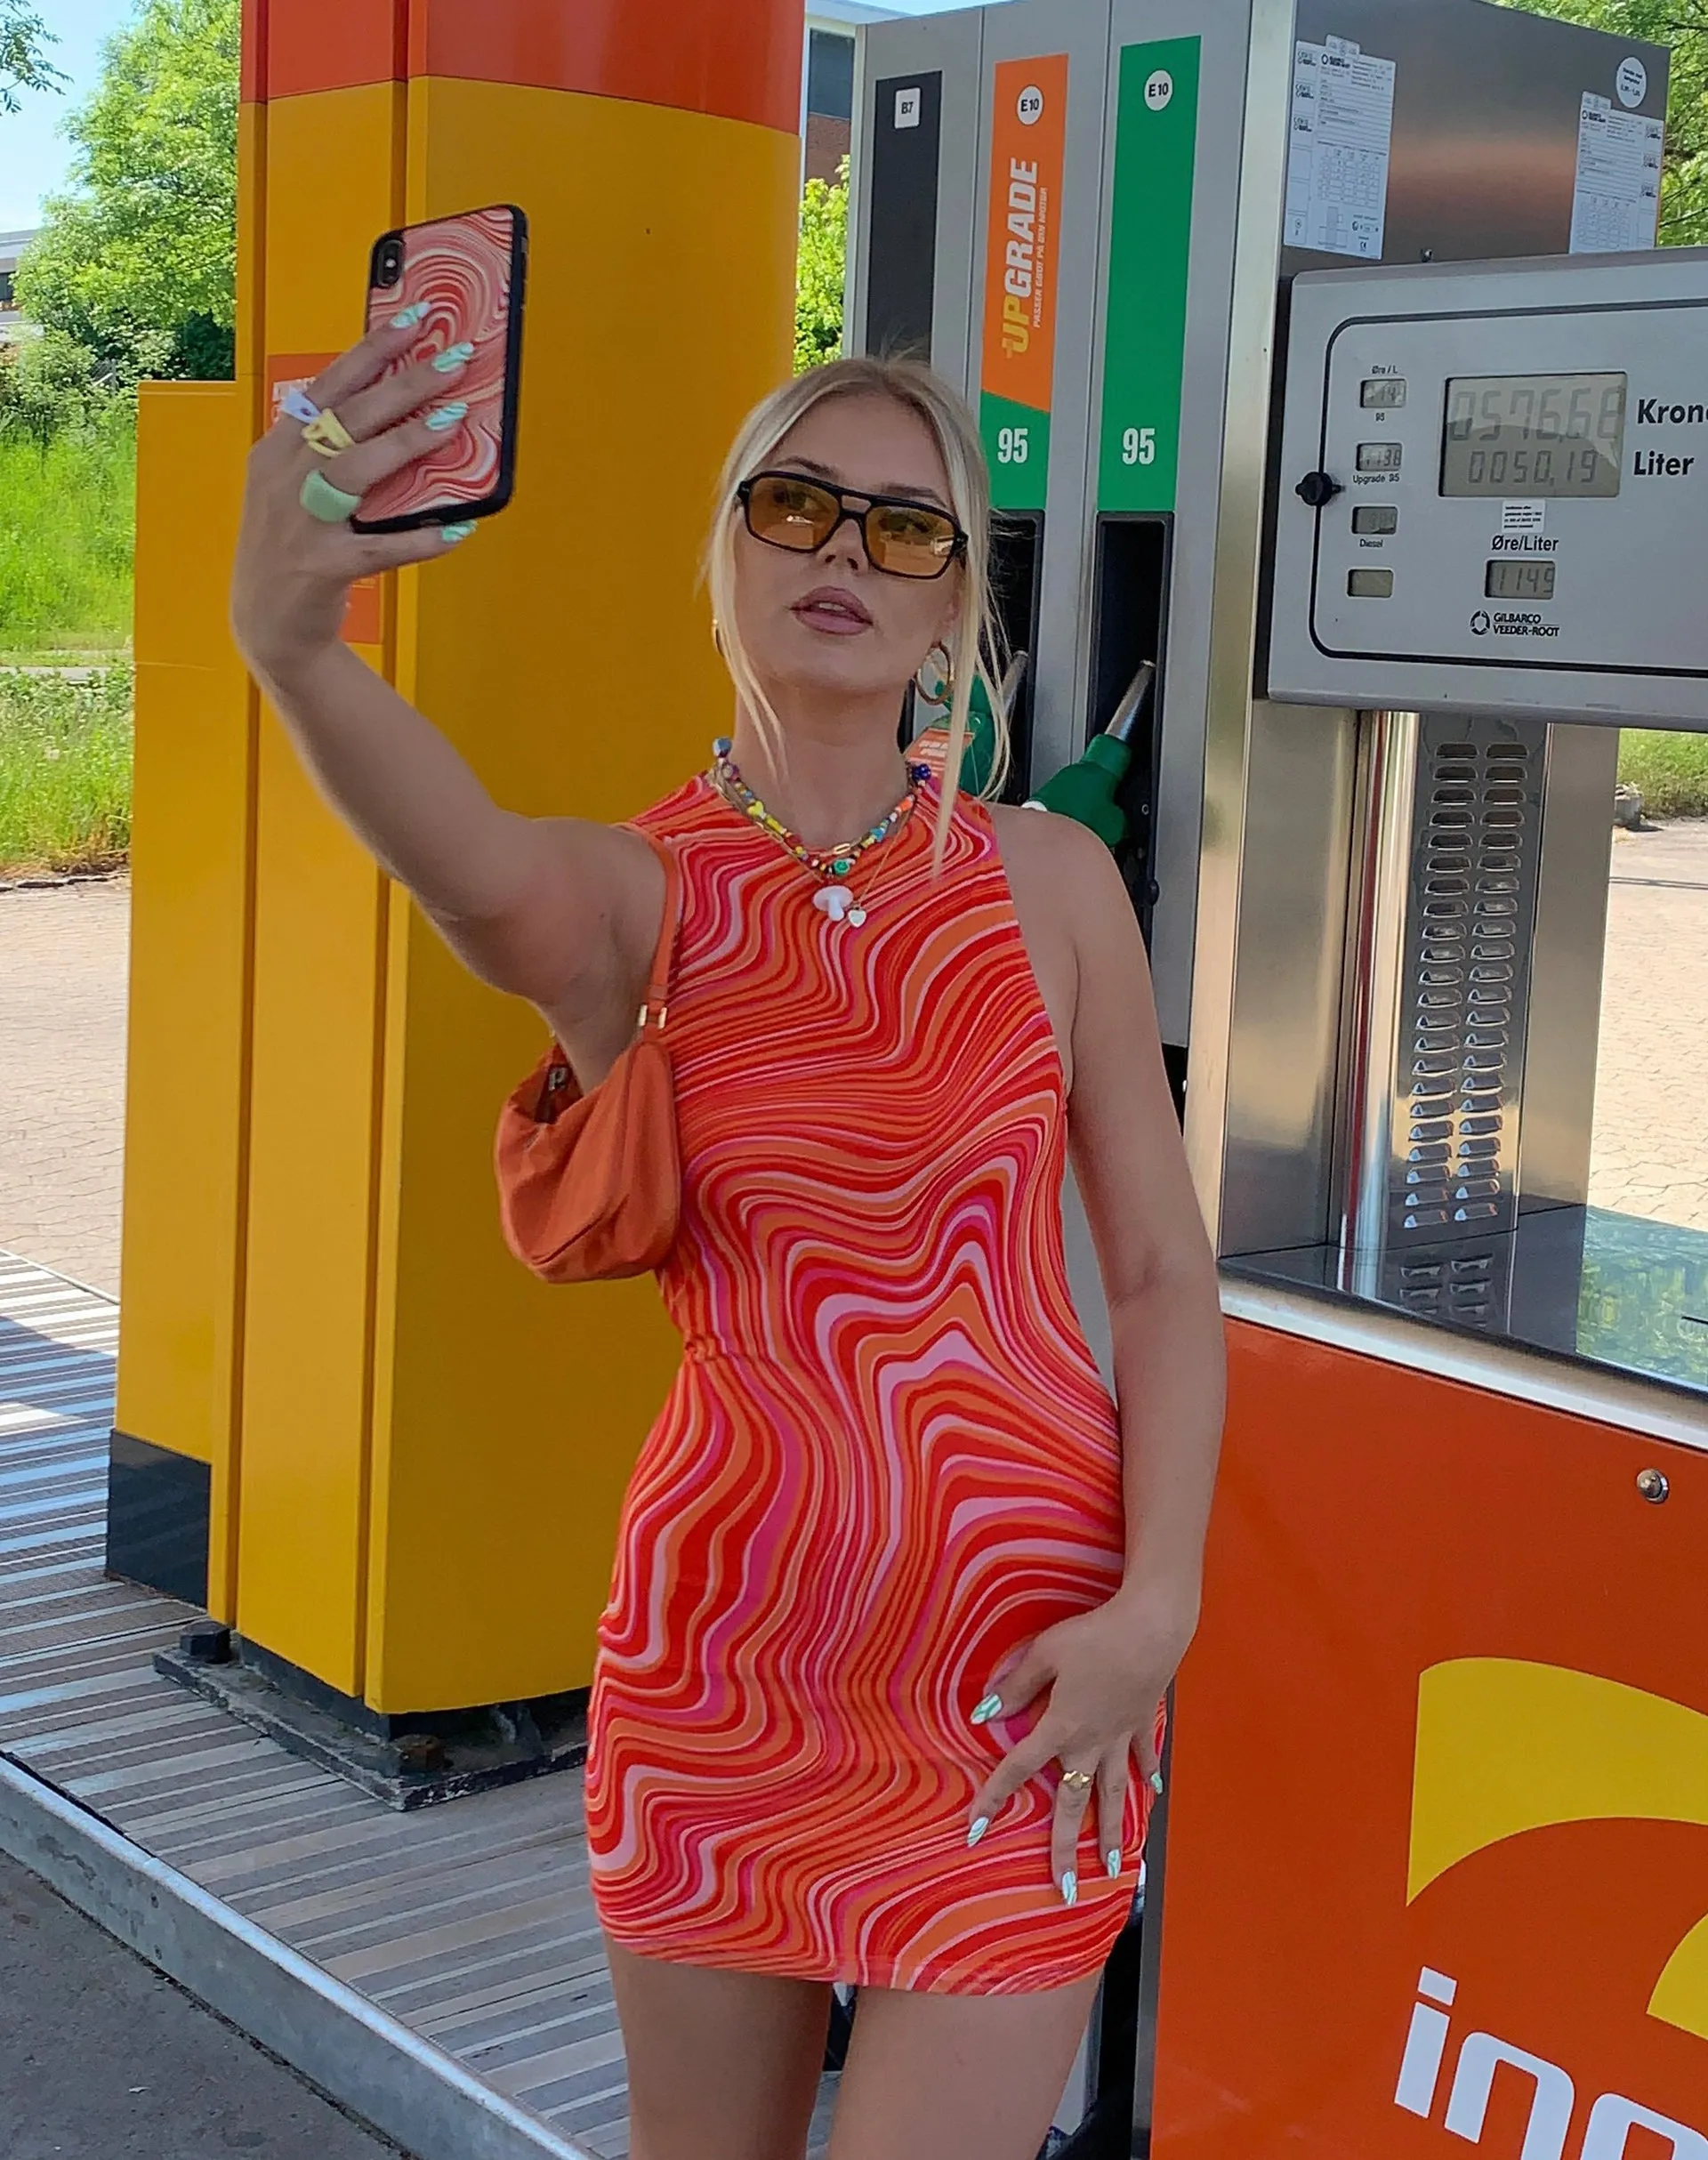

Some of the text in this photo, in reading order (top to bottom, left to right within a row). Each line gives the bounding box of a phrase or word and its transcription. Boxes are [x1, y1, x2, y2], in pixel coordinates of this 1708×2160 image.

[901, 101, 914, 115] B7
[1002, 157, 1037, 353] UPGRADE
[1637, 399, 1708, 424] Kron
[997, 427, 1028, 463] 95
[1122, 427, 1156, 464] 95
[1633, 449, 1695, 476] Liter
[1352, 474, 1386, 485] Upgrade
[1359, 538, 1384, 548] Diesel
[1491, 535, 1559, 552] Øre/Liter
[1493, 612, 1542, 625] GILBARCO
[1494, 625, 1560, 638] VEEDER-ROOT
